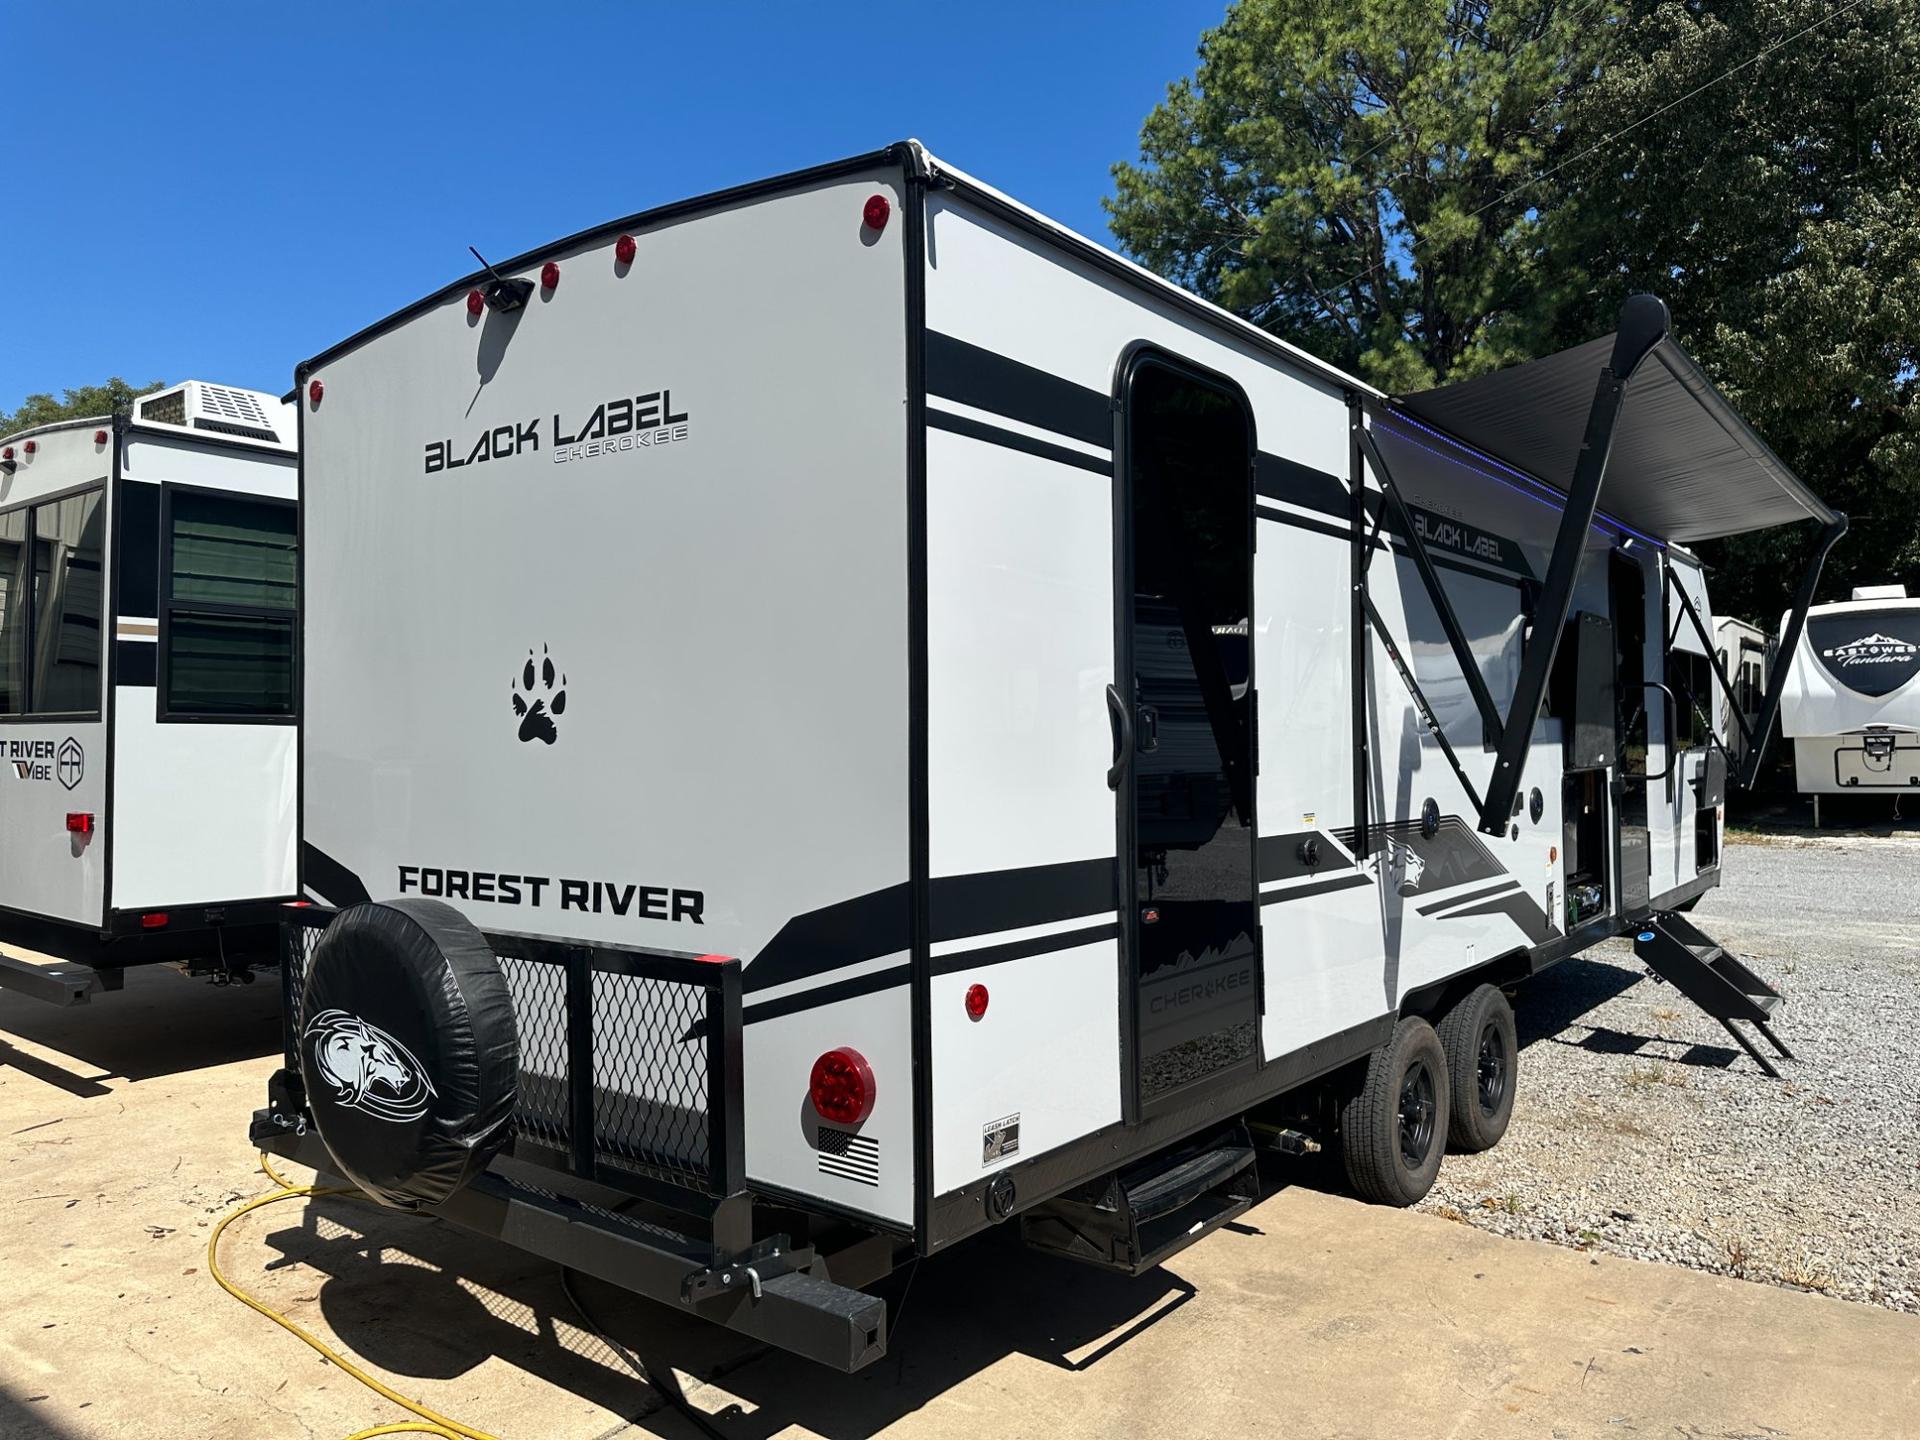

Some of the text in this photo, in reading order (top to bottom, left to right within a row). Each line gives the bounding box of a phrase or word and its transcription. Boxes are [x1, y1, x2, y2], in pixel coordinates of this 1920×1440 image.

[425, 389, 688, 474] BLACK LABEL
[553, 425, 688, 463] CHEROKEE
[1414, 514, 1503, 562] BLACK LABEL
[1837, 653, 1913, 668] Tandara
[10, 740, 55, 758] RIVER
[398, 865, 704, 925] FOREST RIVER
[984, 1122, 1001, 1133] LEASH
